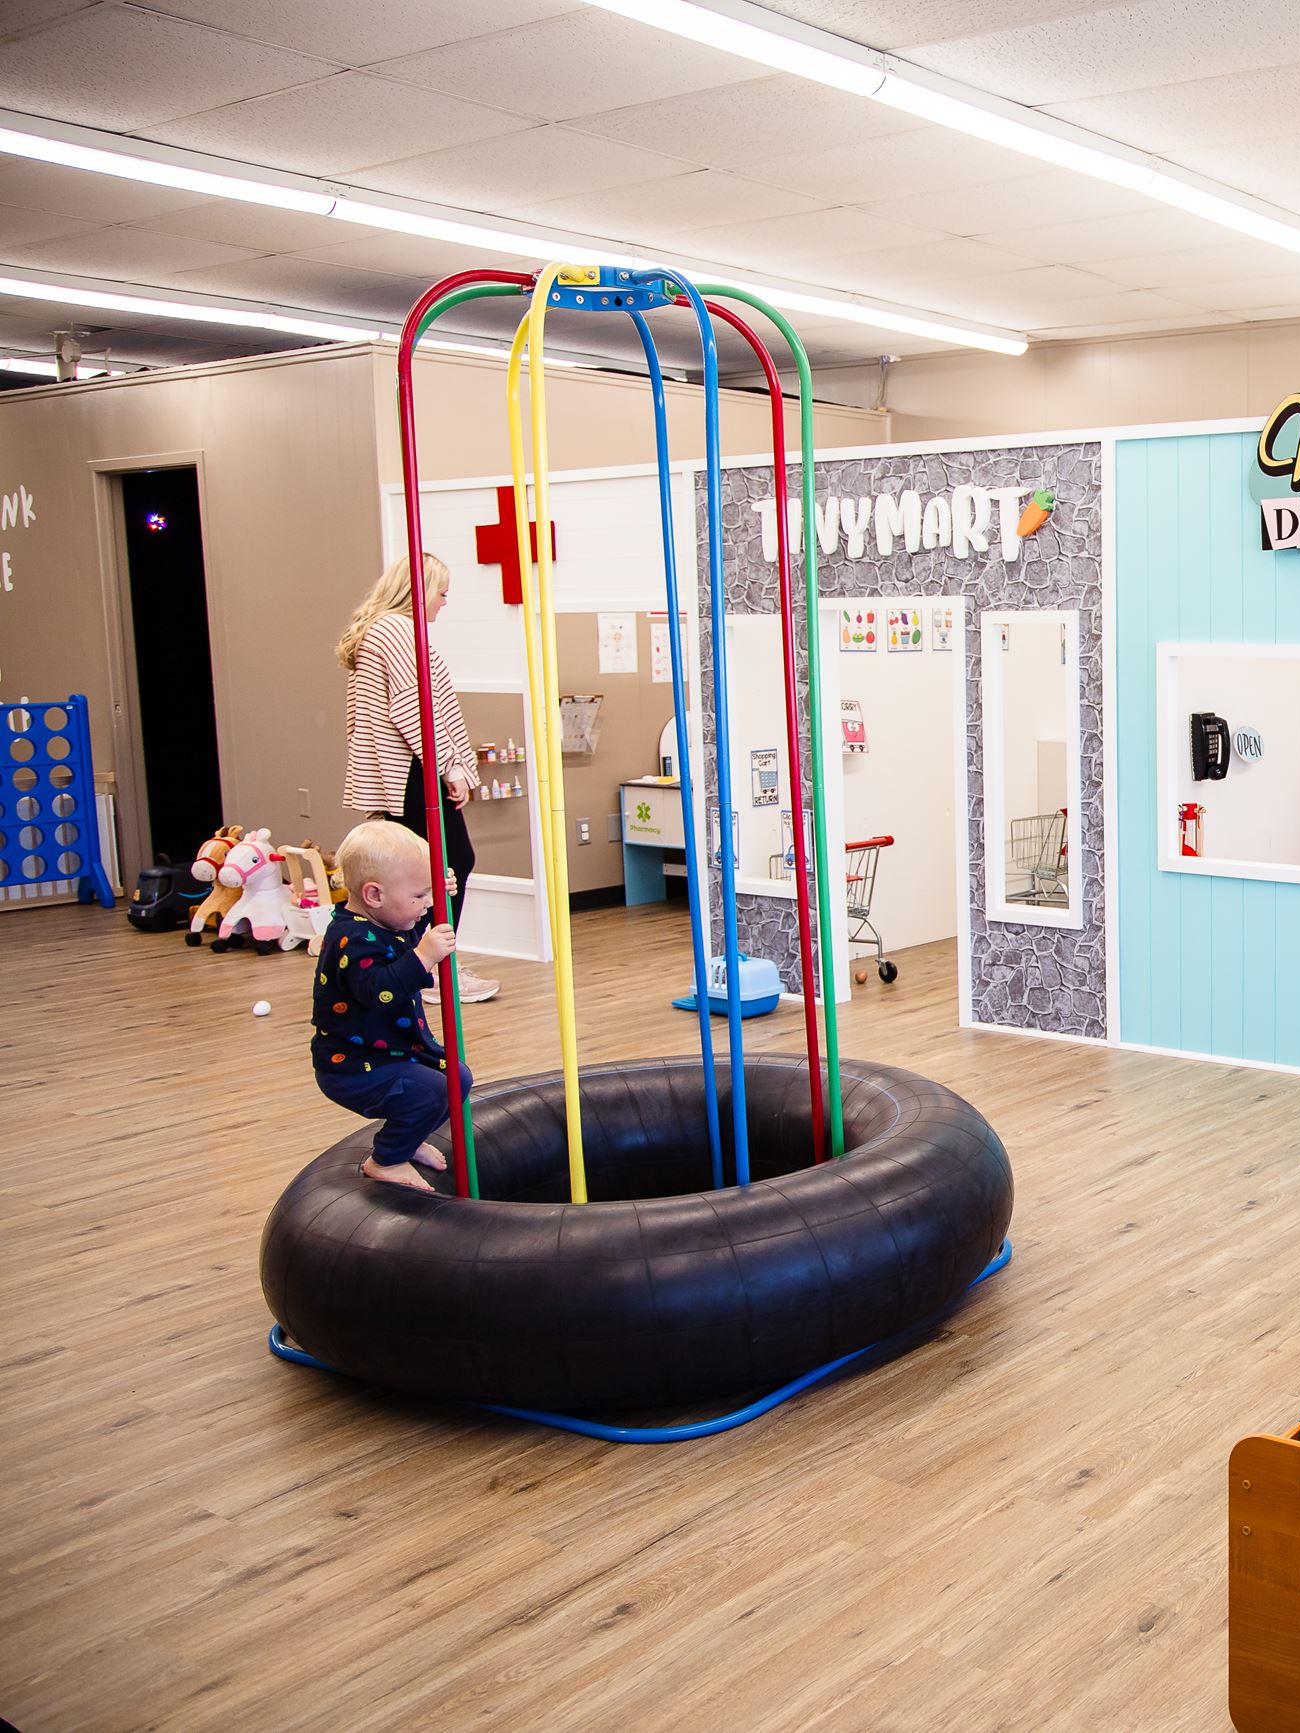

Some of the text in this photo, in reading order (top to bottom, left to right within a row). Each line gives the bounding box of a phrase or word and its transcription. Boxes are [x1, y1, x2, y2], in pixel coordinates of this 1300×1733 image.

[0, 484, 37, 531] NK
[841, 702, 858, 711] ORRY
[1236, 733, 1262, 758] OPEN
[752, 752, 776, 760] Shopping
[754, 794, 778, 805] RETURN
[630, 824, 661, 835] Pharmacy
